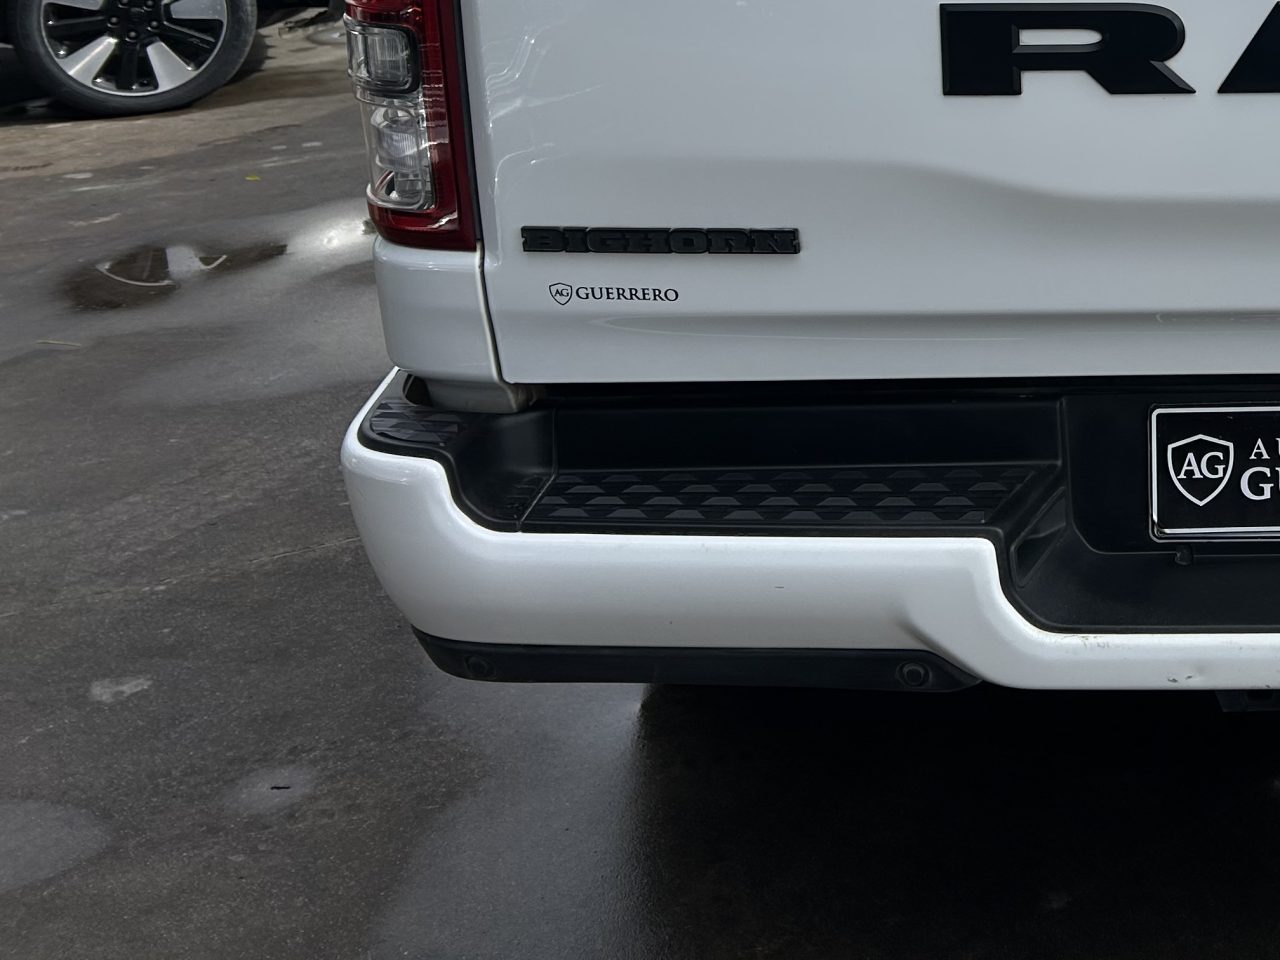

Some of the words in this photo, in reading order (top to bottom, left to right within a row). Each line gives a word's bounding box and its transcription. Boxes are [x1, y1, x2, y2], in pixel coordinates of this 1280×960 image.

[521, 226, 801, 254] BIGHORN
[553, 288, 570, 298] AG
[575, 286, 679, 302] GUERRERO
[1177, 451, 1226, 480] AG
